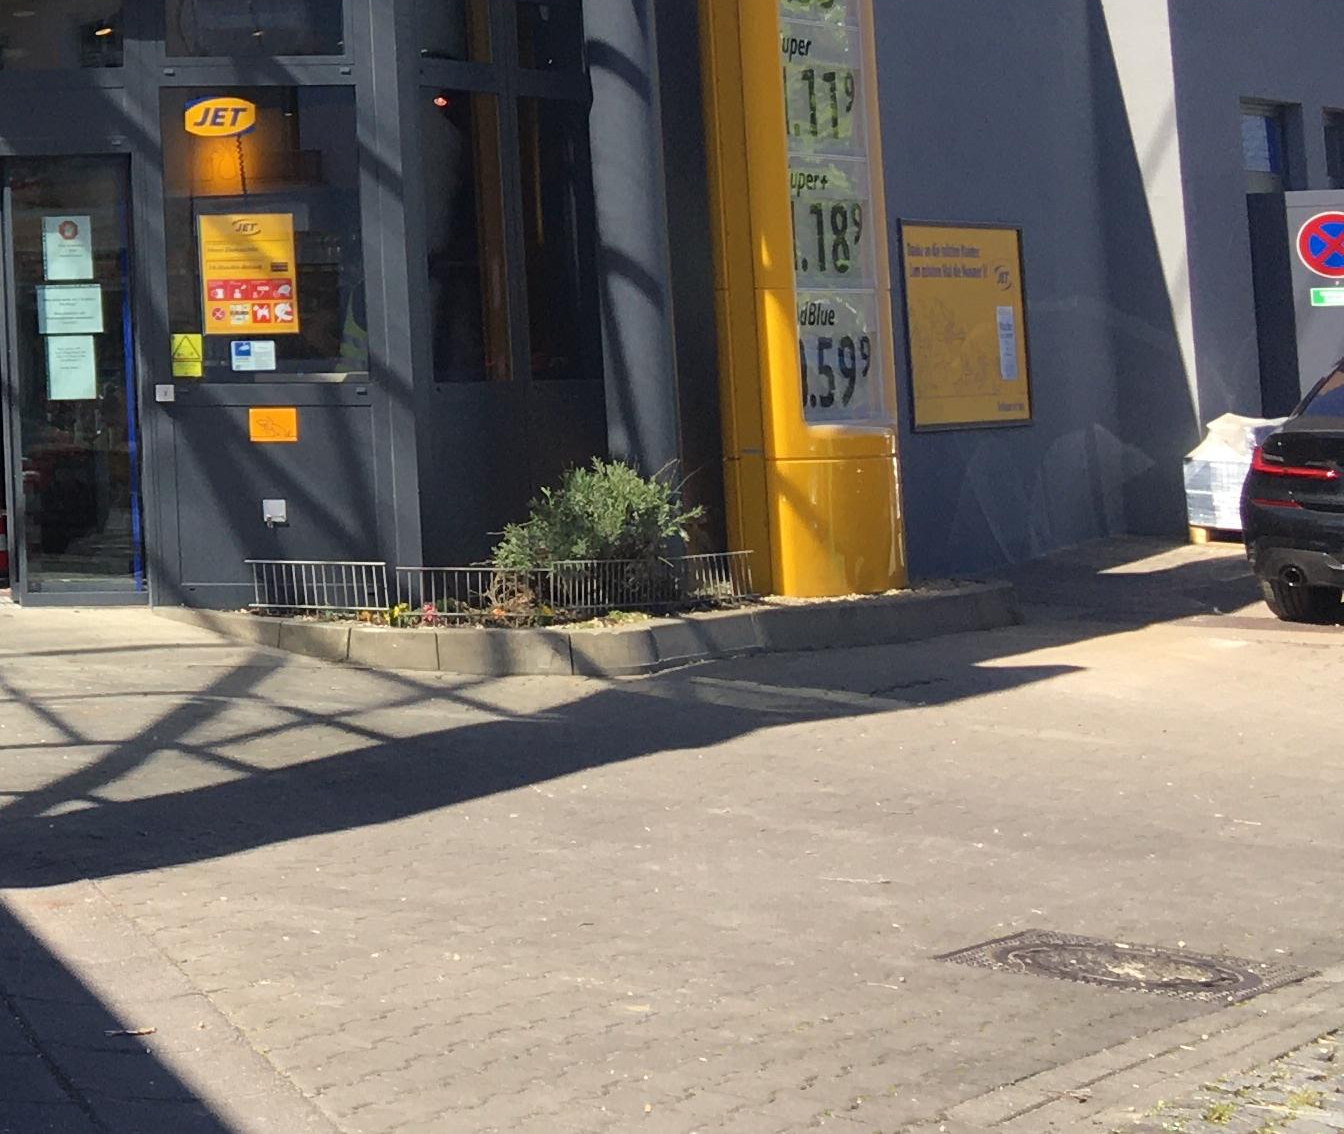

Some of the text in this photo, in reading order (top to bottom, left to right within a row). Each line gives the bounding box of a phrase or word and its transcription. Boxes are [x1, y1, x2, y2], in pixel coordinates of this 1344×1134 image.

[782, 37, 811, 62] uper
[193, 107, 248, 127] JET
[790, 171, 828, 197] uper+
[236, 224, 255, 232] JET
